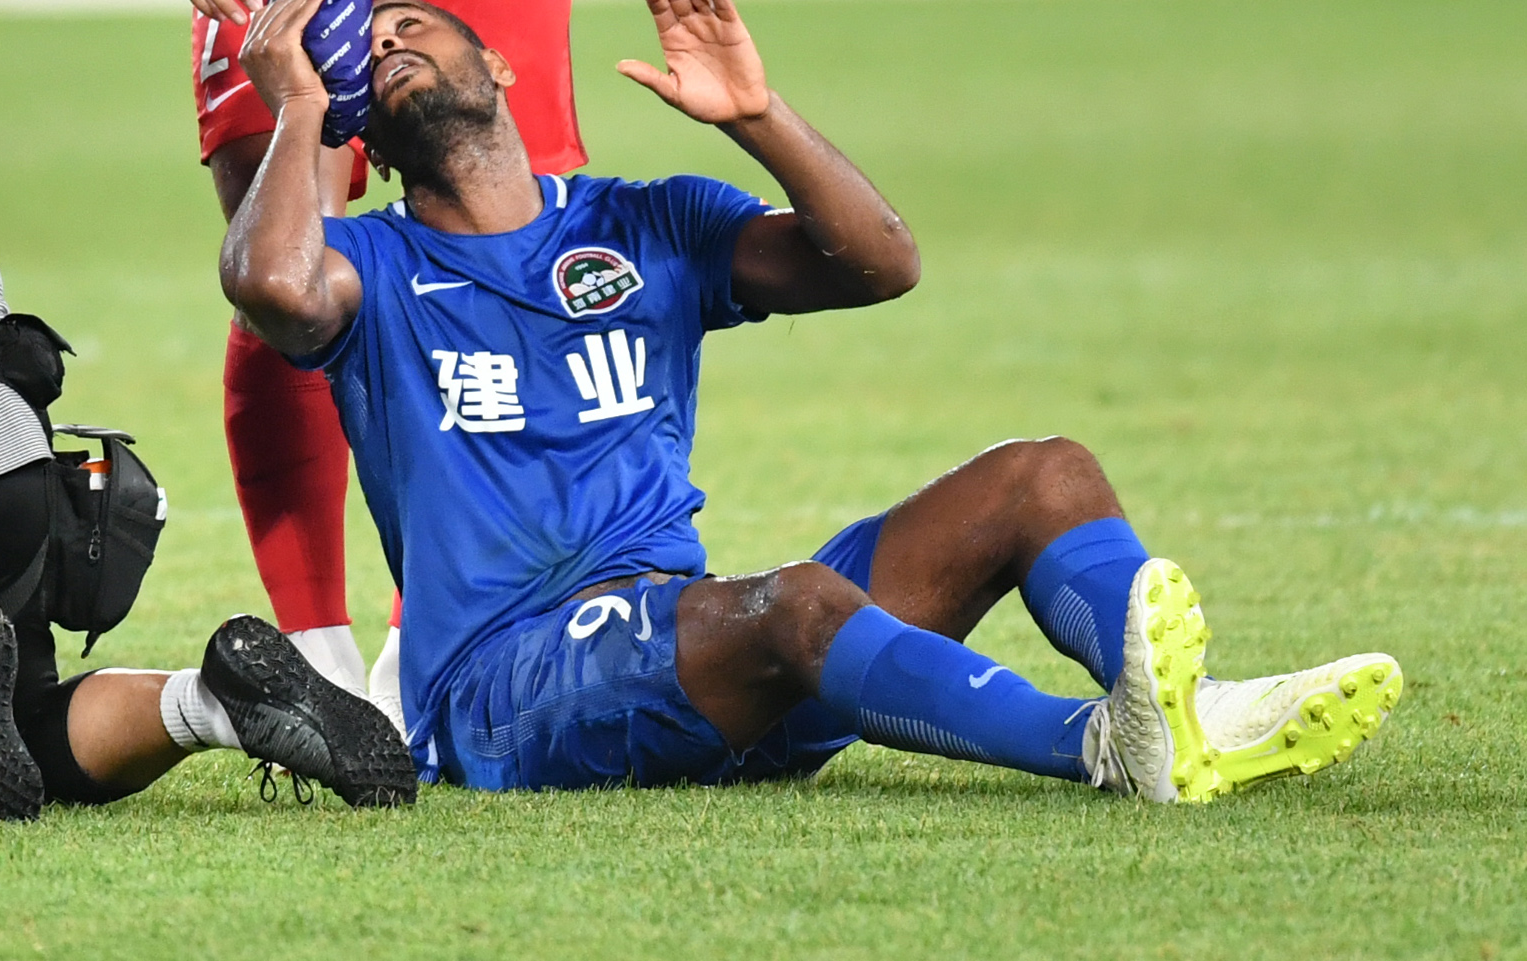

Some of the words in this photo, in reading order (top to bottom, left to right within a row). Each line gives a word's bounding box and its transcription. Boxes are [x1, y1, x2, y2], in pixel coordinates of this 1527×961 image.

[329, 1, 357, 31] SUPPORT
[321, 41, 352, 72] SUPPORT
[432, 329, 656, 433] 建业
[568, 595, 632, 640] 6
